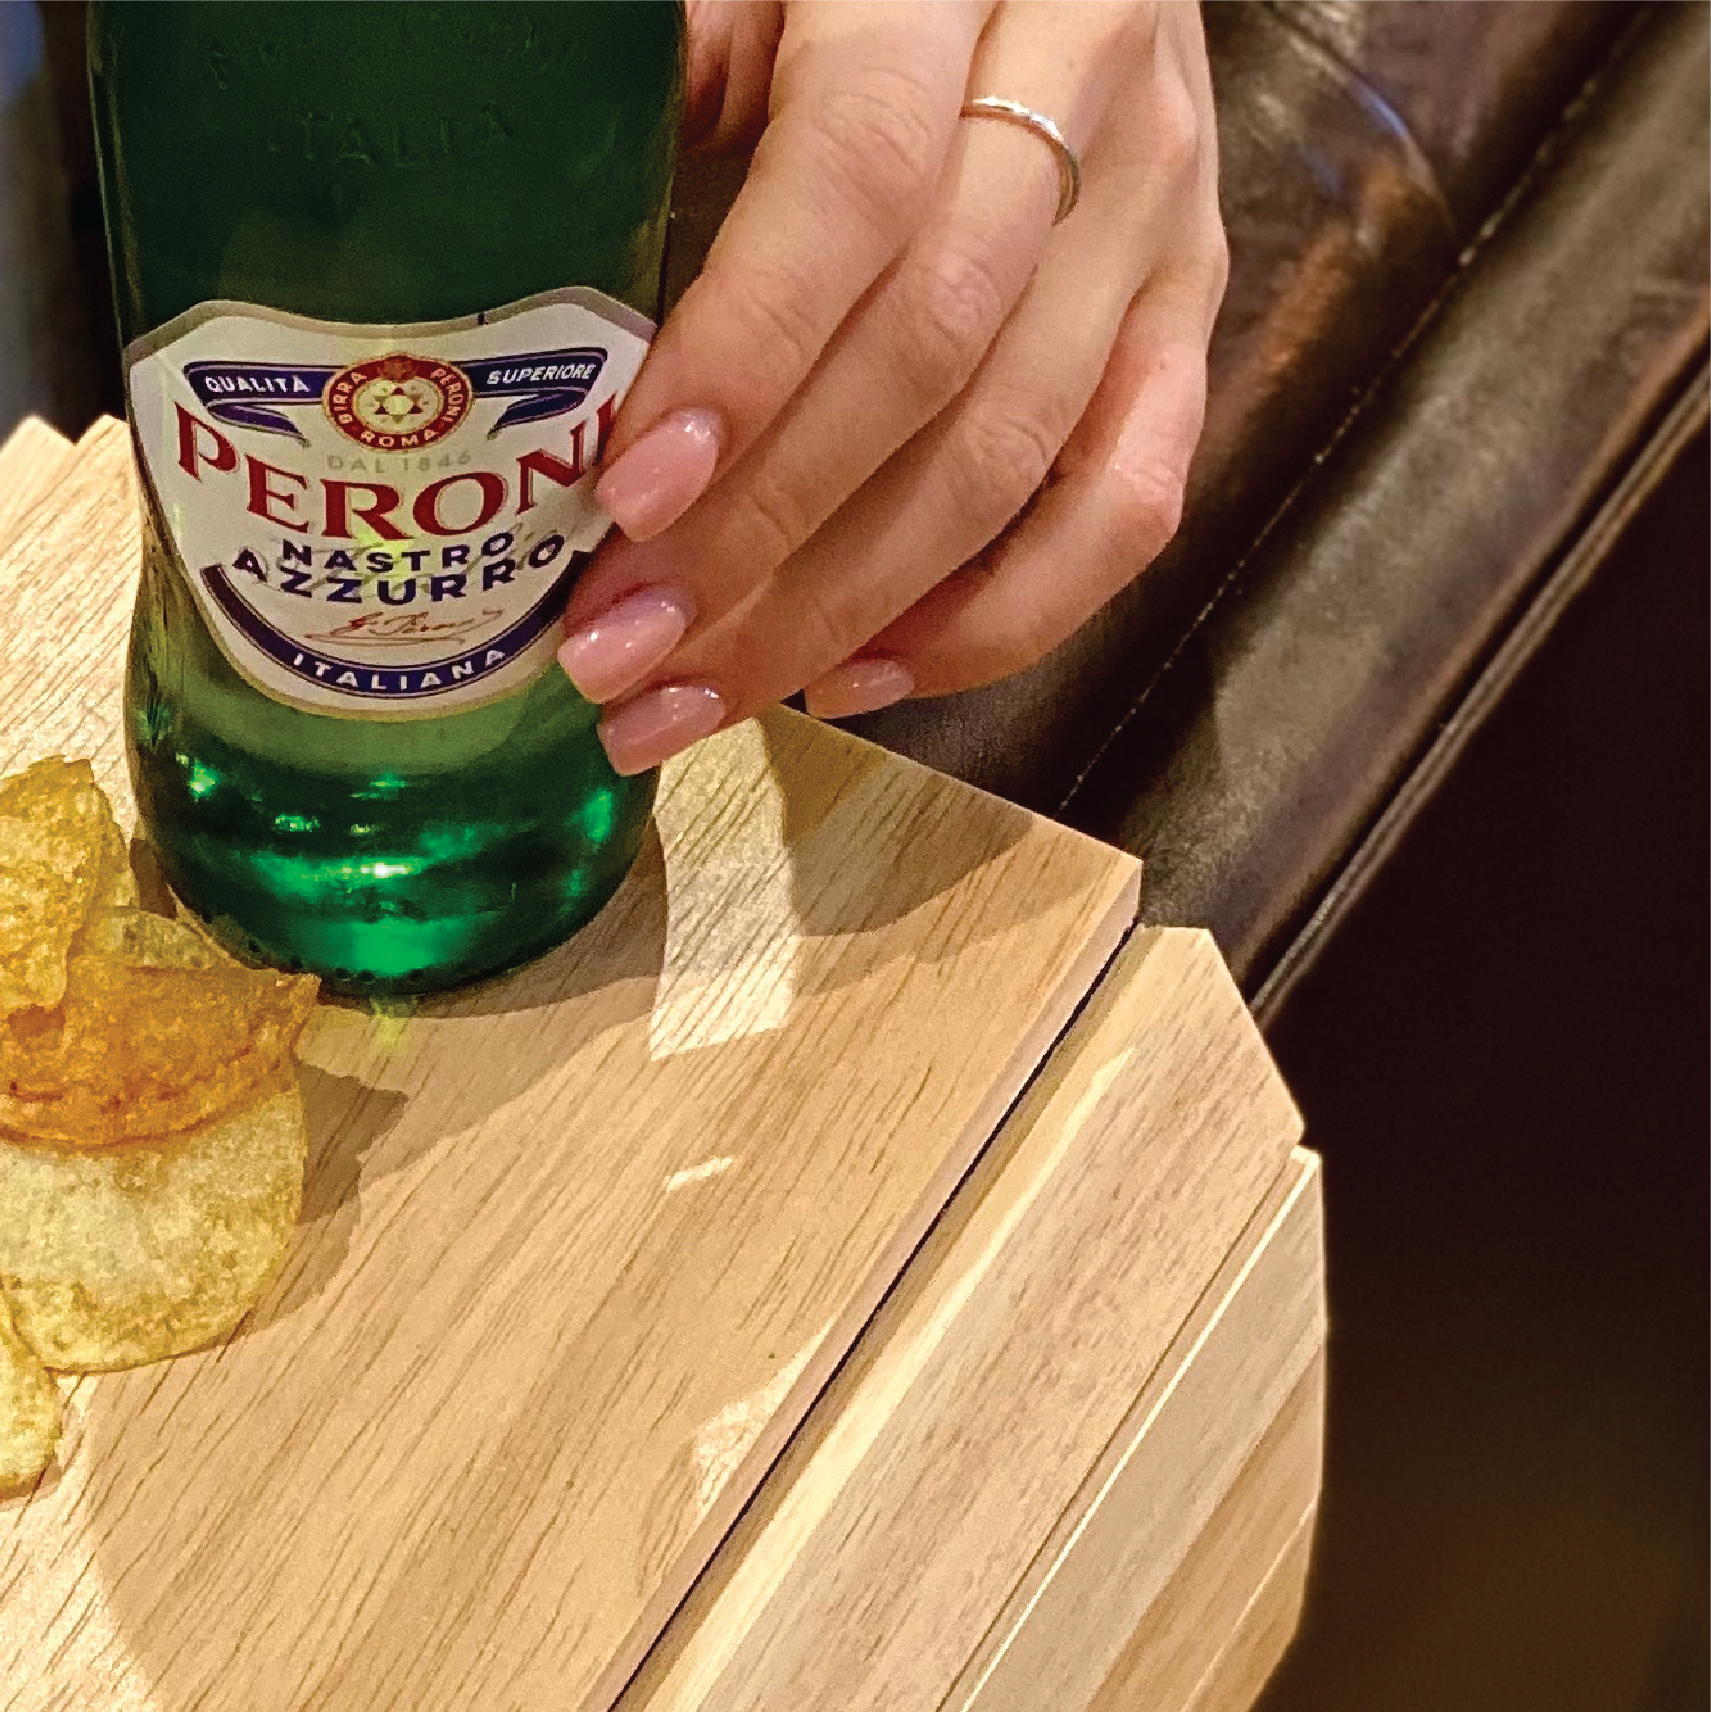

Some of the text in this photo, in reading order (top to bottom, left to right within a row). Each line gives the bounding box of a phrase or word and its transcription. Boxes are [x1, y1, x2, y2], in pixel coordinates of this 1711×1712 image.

[487, 362, 596, 385] SUPERIORE
[332, 368, 464, 426] BIRRA PERONI
[360, 428, 440, 449] ROMA
[327, 453, 471, 474] DAL 1846
[232, 534, 566, 606] AZZURRO
[282, 531, 515, 572] NASTRO
[293, 649, 506, 691] ITALIANA
